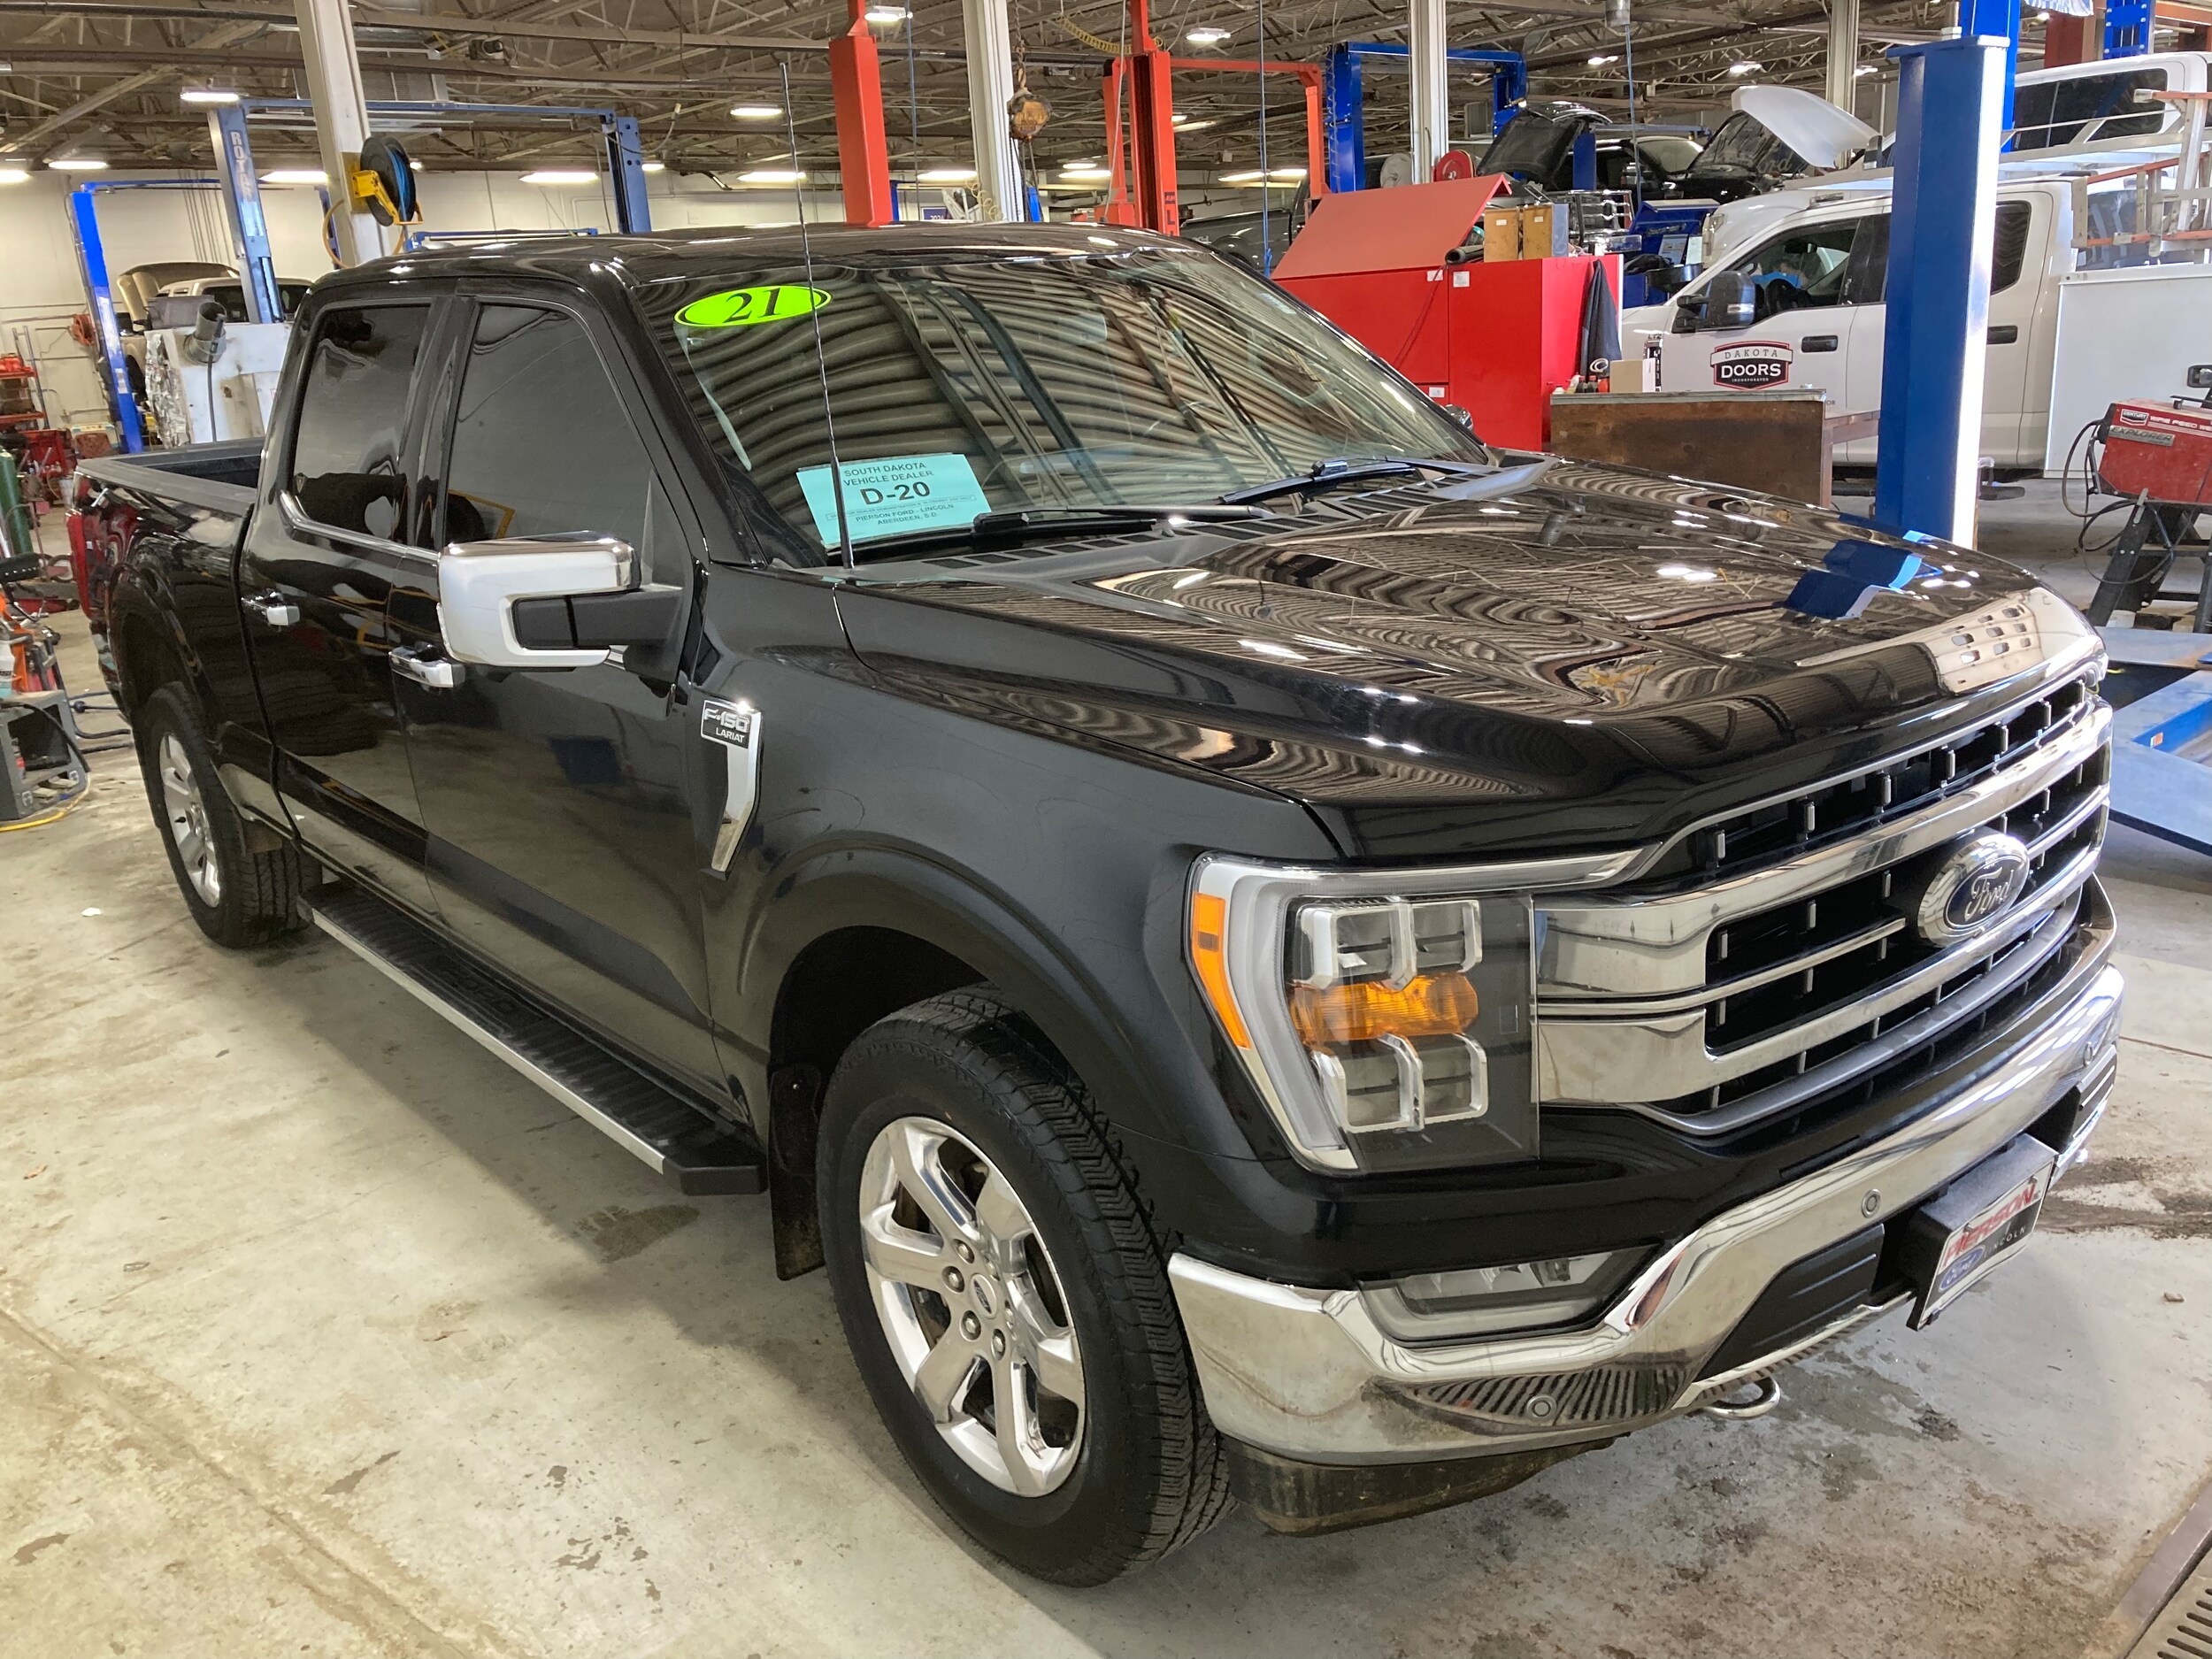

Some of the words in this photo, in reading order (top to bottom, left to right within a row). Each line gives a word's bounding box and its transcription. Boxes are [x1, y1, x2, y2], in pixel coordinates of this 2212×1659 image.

[723, 288, 781, 323] 21
[1724, 349, 1778, 359] DAKOTA
[1721, 364, 1781, 379] DOORS
[2172, 419, 2198, 428] FEED
[2111, 426, 2172, 441] EXPLORER
[844, 465, 880, 477] SOUTH
[884, 462, 926, 472] DAKOTA
[843, 474, 891, 487] VEHICLE
[892, 470, 933, 481] DEALER
[860, 481, 931, 505] D-20
[856, 512, 890, 522] PIERSON
[920, 503, 954, 512] LINCOLN
[877, 515, 923, 526] ABERDEEN,
[704, 708, 749, 733] F-150
[715, 727, 745, 743] LARIAT
[1964, 867, 2015, 921] Ford
[1942, 1182, 2037, 1267] PIERSON
[1984, 1226, 2026, 1257] LINCOLN
